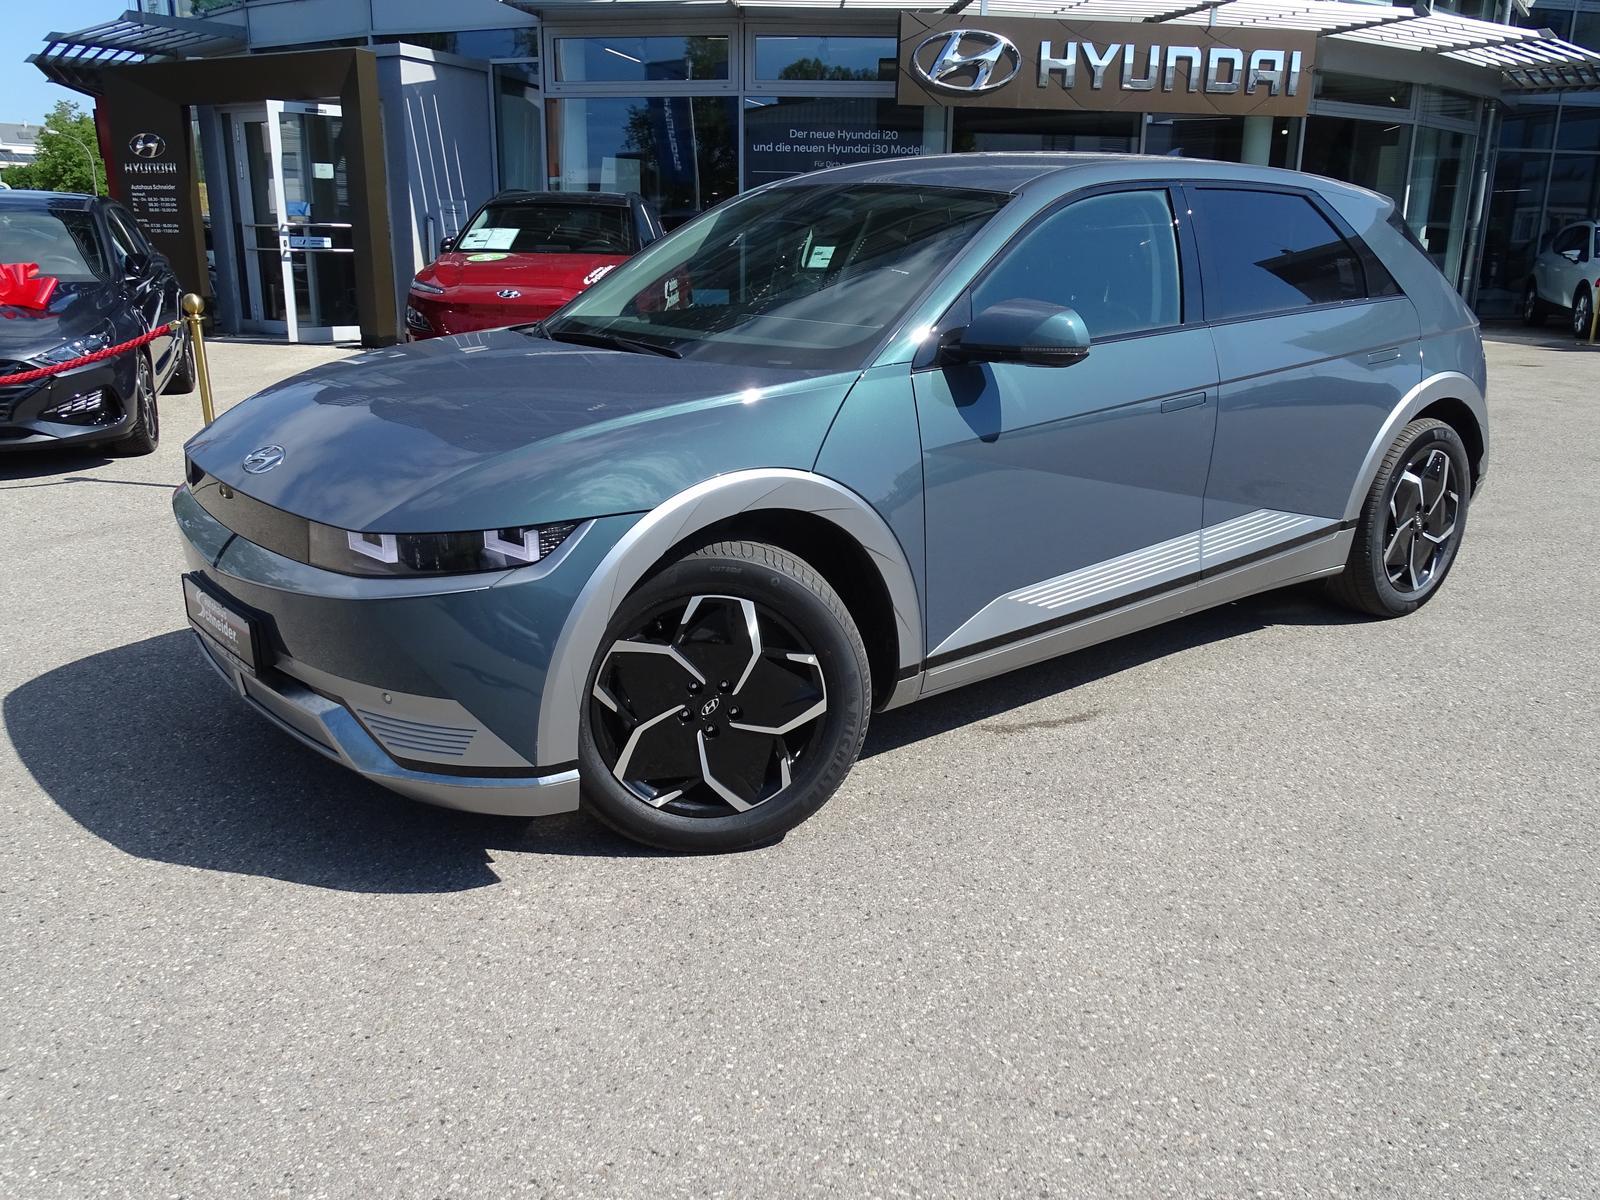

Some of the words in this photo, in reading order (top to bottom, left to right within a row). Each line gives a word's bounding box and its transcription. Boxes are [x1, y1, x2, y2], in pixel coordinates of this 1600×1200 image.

[1037, 40, 1302, 97] HYUNDAI
[789, 128, 807, 139] Der
[810, 130, 835, 139] neue
[837, 129, 881, 141] Hyundai
[882, 130, 899, 140] i20
[753, 141, 773, 152] und
[775, 142, 791, 152] die
[793, 144, 825, 153] neuen
[827, 143, 870, 154] Hyundai
[872, 144, 888, 154] i30
[124, 162, 177, 174] HYUNDAI
